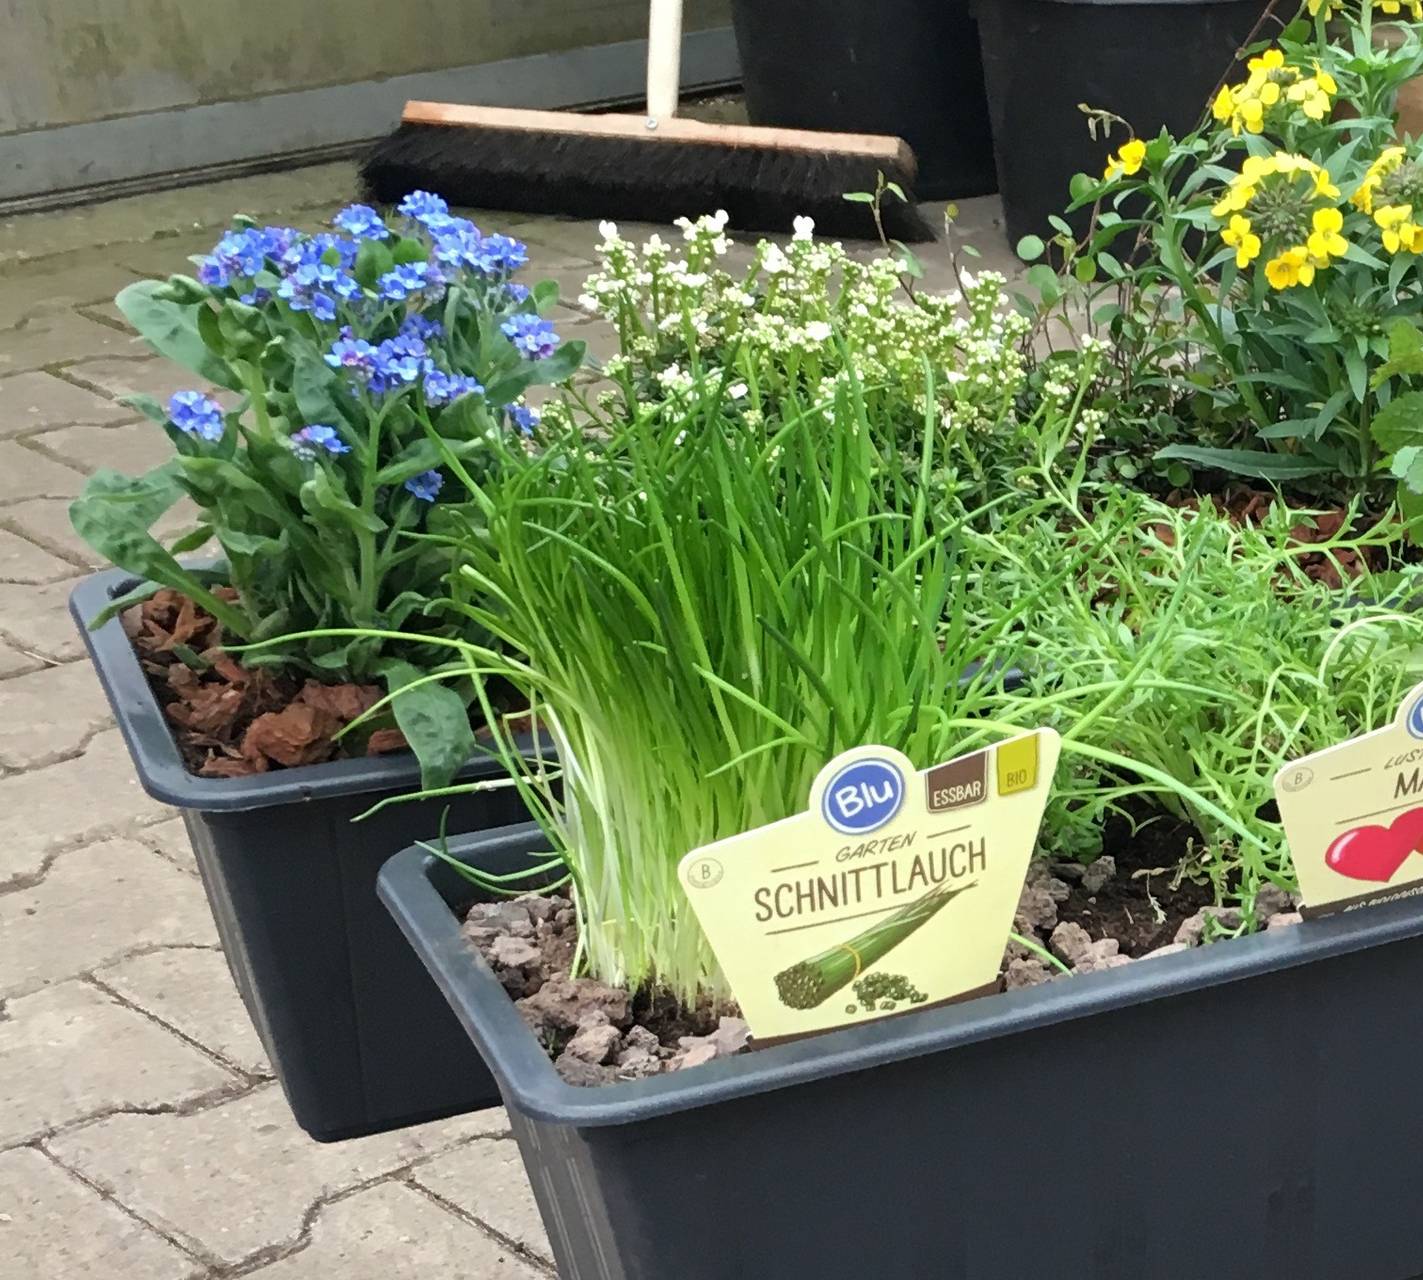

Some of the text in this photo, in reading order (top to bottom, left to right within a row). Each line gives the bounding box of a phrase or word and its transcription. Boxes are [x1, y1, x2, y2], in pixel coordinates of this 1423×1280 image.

[1006, 768, 1027, 787] BIO
[835, 780, 895, 819] Blu
[933, 781, 982, 808] ESSBAR
[835, 831, 918, 863] GARTEN
[754, 836, 987, 922] SCHNITTLAUCH
